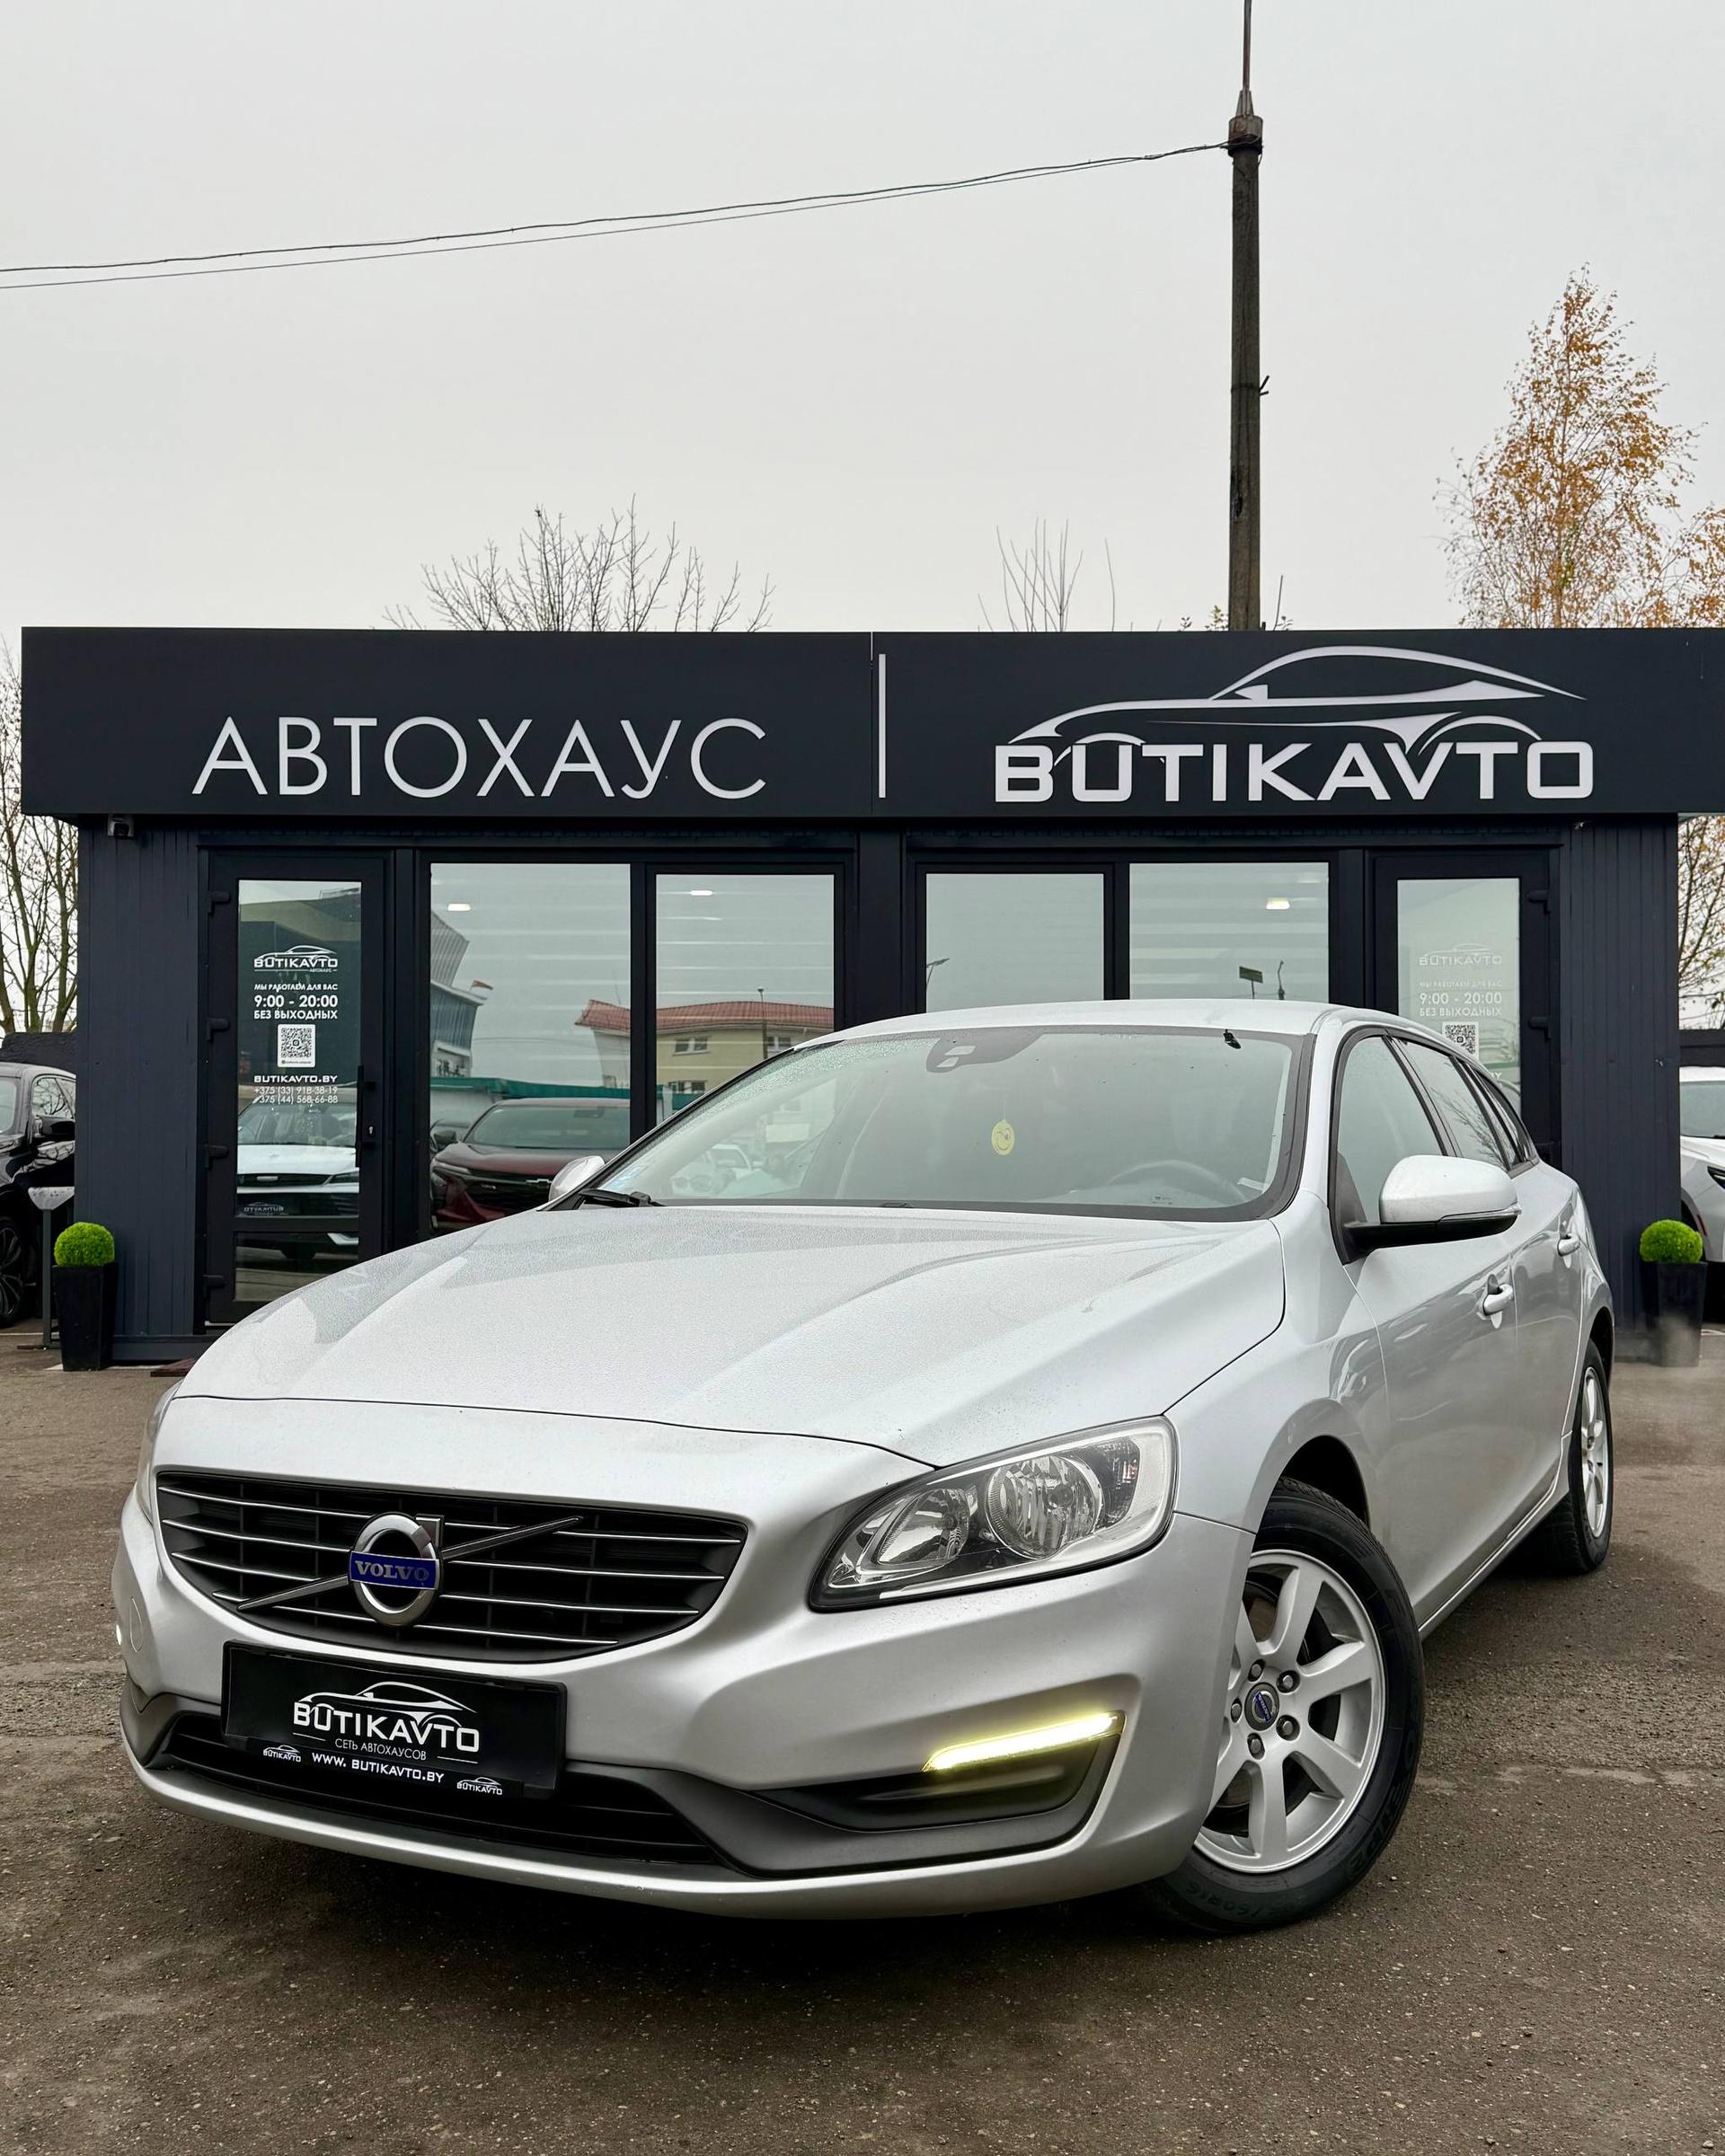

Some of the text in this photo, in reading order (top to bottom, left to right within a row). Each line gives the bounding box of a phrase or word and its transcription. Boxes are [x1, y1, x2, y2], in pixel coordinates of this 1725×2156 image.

[192, 716, 765, 799] АВТОХАУС
[995, 741, 1593, 802] BUTIKAVTO
[254, 959, 338, 968] BUTIKAVTO
[254, 994, 284, 1007] 9:00
[299, 994, 338, 1007] 20:00
[1420, 993, 1448, 1004] 9:00
[1464, 992, 1501, 1004] 20:00
[254, 1010, 338, 1021] БЕЗ ВЫХОДНЫХ
[1420, 1007, 1501, 1016] БЕЗ ВЫХОДНЫХ
[254, 1086, 338, 1096] +375 (33) 918-38-19
[278, 1095, 294, 1104] (44)
[355, 1560, 429, 1581] VOLVO
[293, 1701, 479, 1752] BUTIKAVTO
[263, 1750, 301, 1762] BUTIKAVTO
[335, 1739, 427, 1761] СЕТЬ АВТОХАУСОВ
[312, 1753, 444, 1783] WWW. BUTIKAVTO.BY
[457, 1782, 502, 1795] BUTIKAVTO
